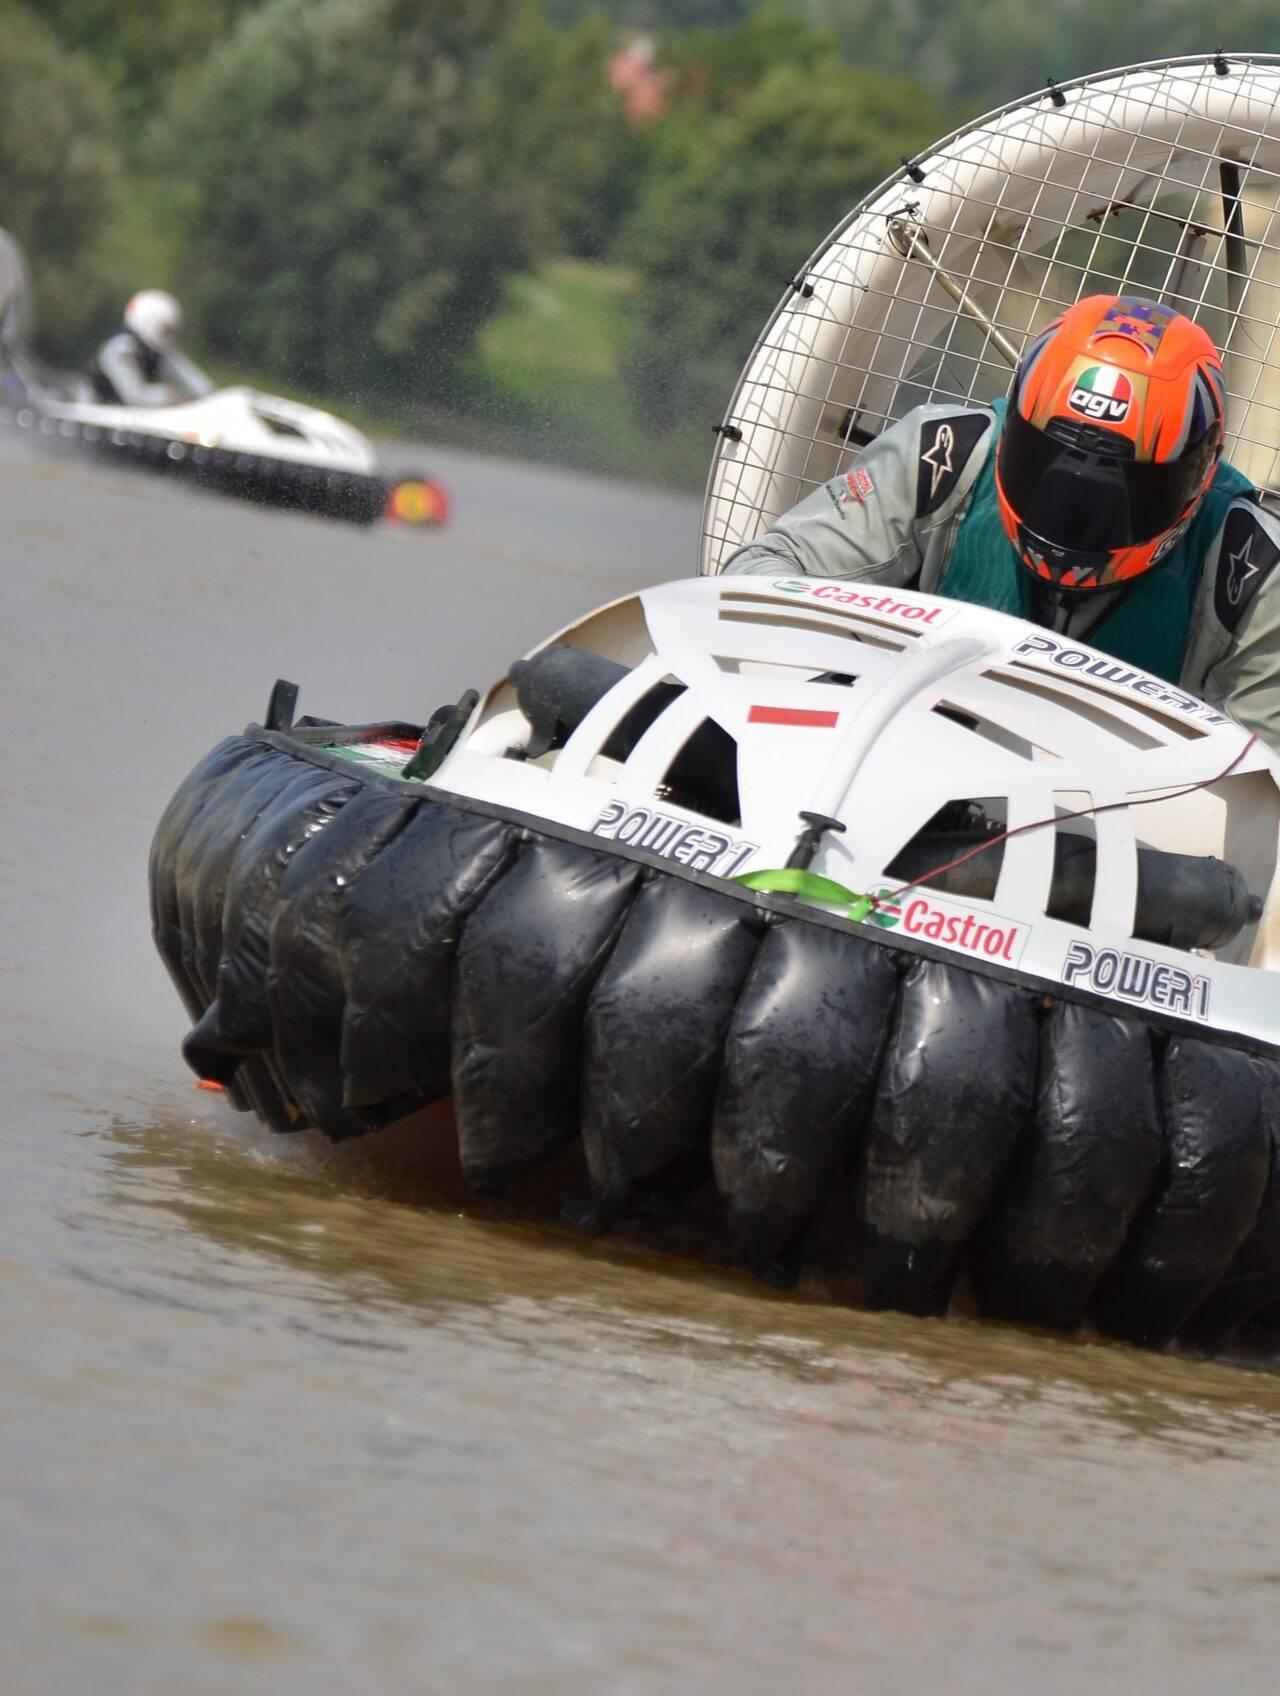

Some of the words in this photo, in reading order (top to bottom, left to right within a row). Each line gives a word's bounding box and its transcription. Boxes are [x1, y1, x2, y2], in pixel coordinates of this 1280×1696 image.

[1069, 388, 1128, 418] agv
[811, 585, 943, 625] Castrol
[1012, 633, 1232, 726] POWER1
[588, 799, 761, 878] POWER1
[902, 899, 1018, 962] Castrol
[1061, 939, 1212, 1022] POWER1
